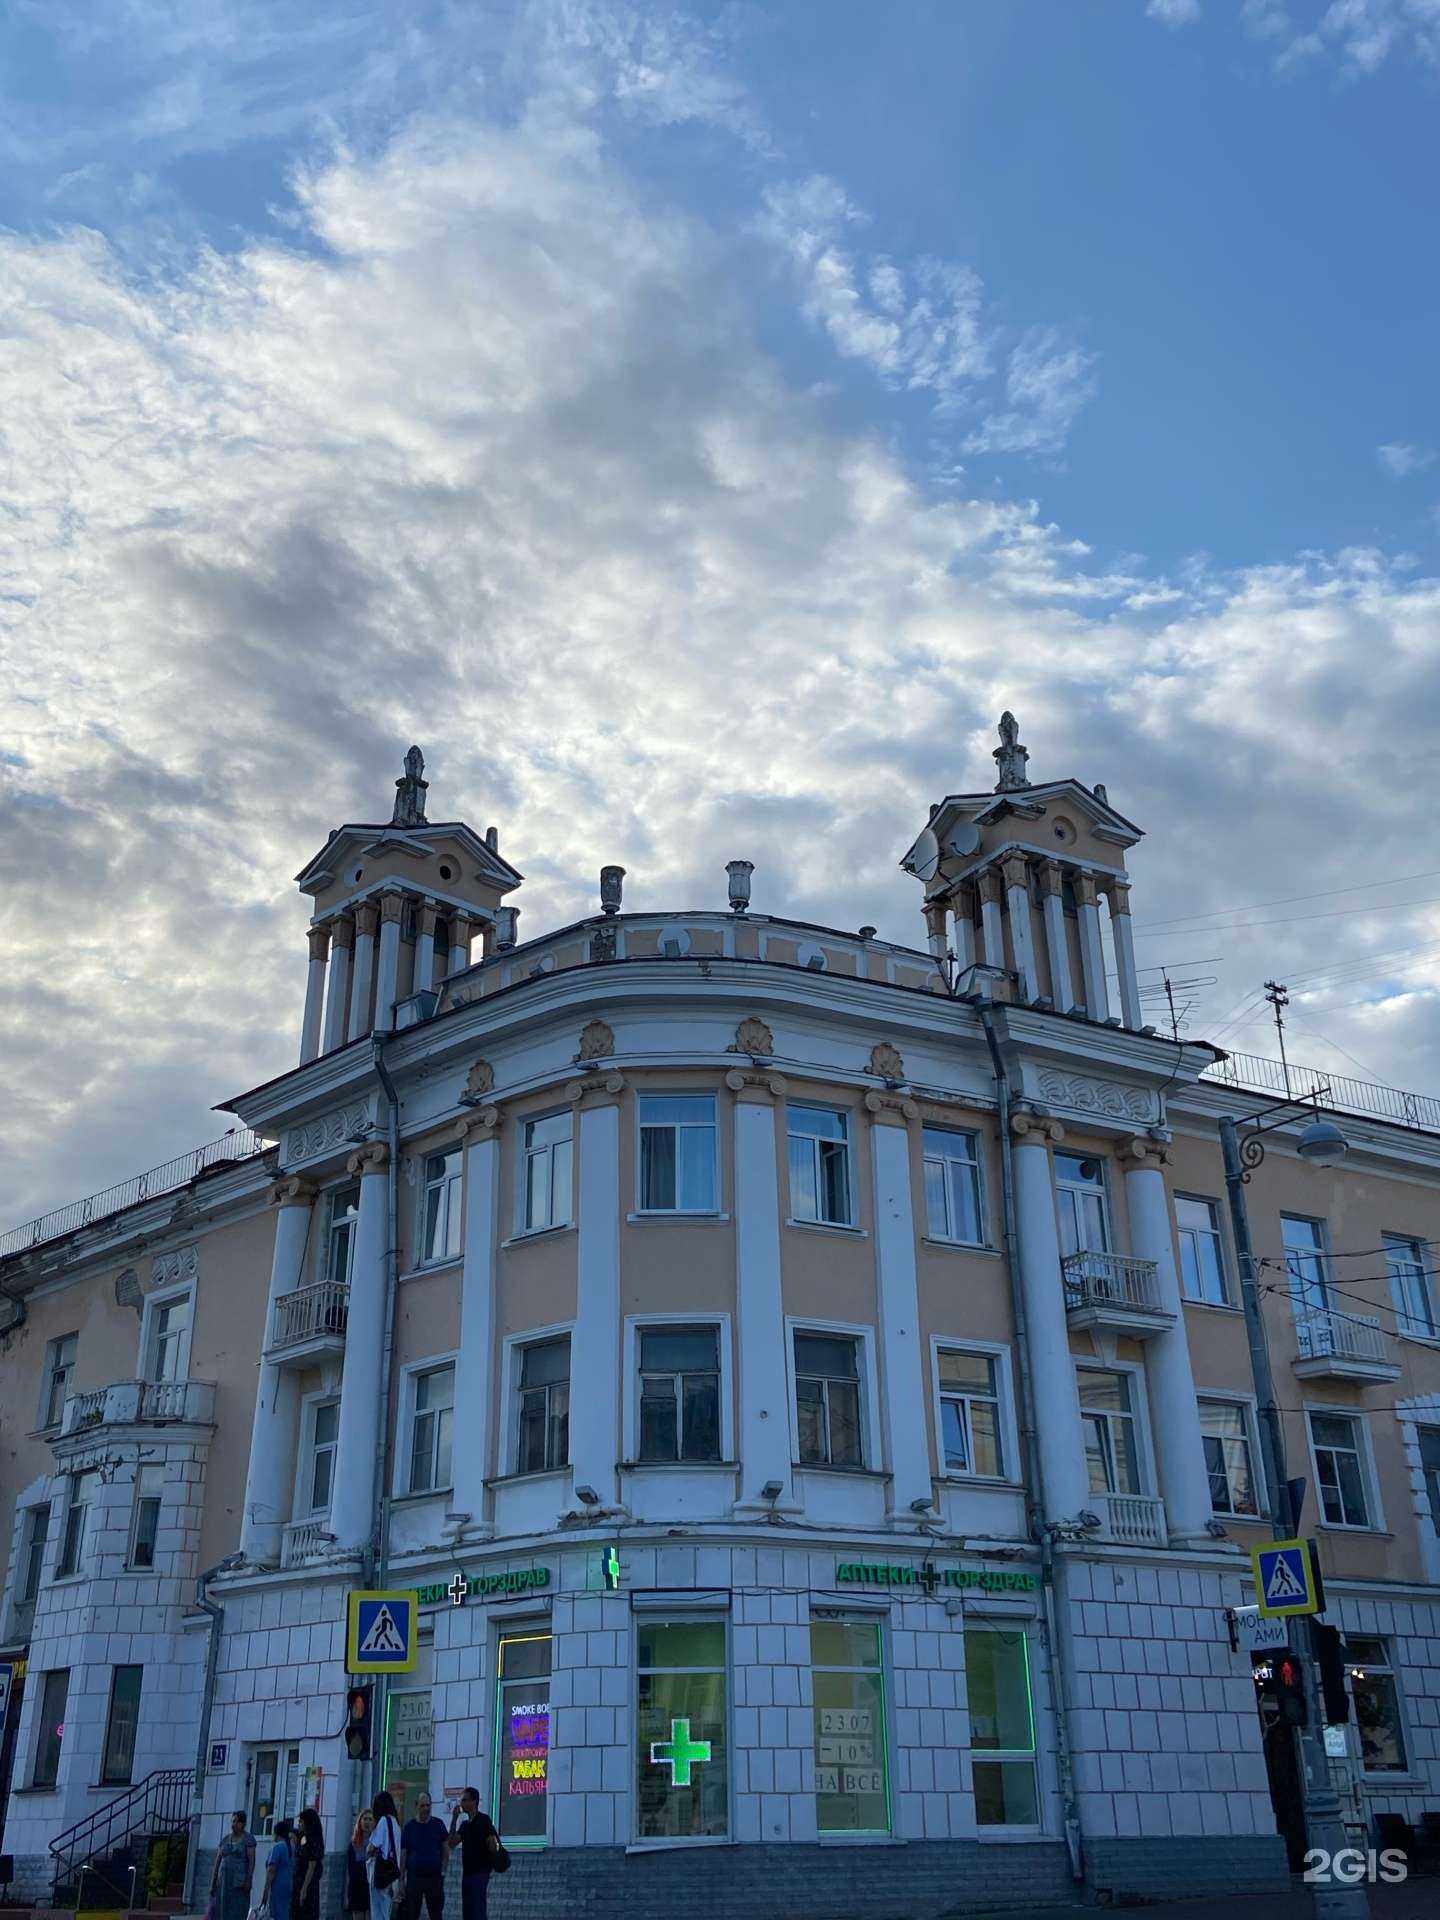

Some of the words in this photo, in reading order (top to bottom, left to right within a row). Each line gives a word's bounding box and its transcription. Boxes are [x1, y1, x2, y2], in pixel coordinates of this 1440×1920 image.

[470, 1568, 549, 1595] ГОРЗДРАВ
[838, 1564, 915, 1585] АПТЕКИ
[945, 1570, 1038, 1591] ГОРЗДРАВ
[1255, 1628, 1284, 1643] АМИ
[512, 1704, 535, 1716] SMOKE
[512, 1760, 545, 1779] ТАБАК
